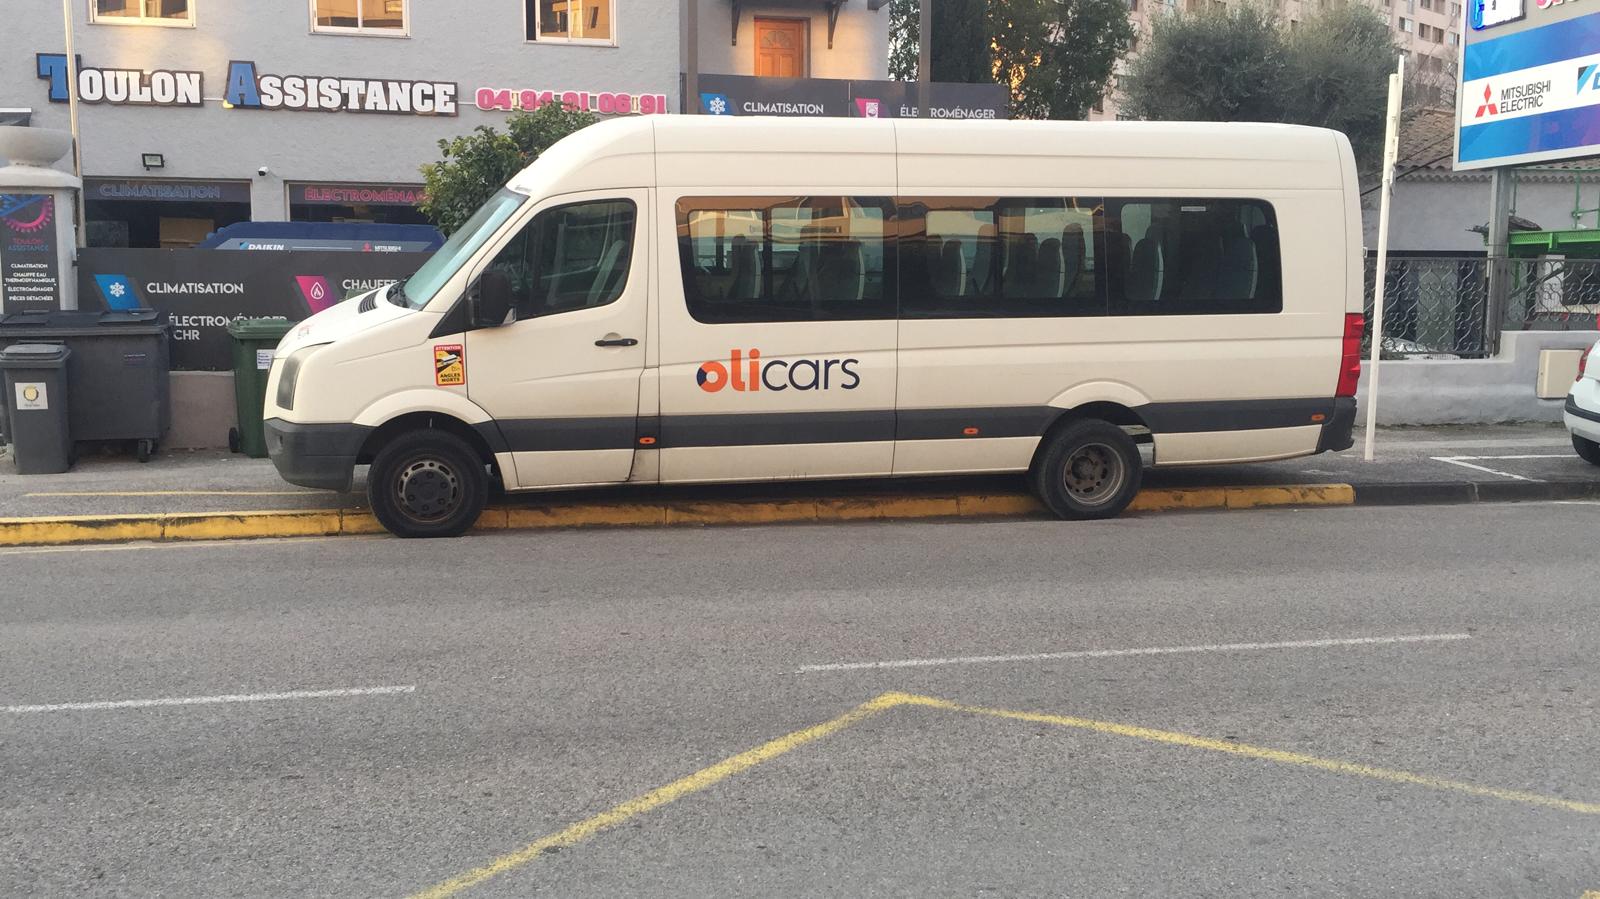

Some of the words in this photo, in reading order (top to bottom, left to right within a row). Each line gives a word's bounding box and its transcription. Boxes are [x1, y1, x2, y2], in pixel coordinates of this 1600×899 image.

[37, 54, 203, 105] TOULON
[227, 61, 457, 114] ASSISTANCE
[1501, 80, 1551, 100] MITSUBISHI
[477, 88, 512, 110] 04
[519, 90, 553, 111] 94
[598, 93, 632, 114] 06
[640, 94, 666, 115] 91
[743, 102, 824, 114] CLIMATISATION
[1500, 95, 1544, 114] ELECTRIC
[900, 104, 996, 119] ÉLEROMÉNAGER
[99, 183, 221, 199] CLIMATISATION
[146, 282, 244, 294] CLIMATISATION
[173, 329, 200, 340] CHR
[697, 348, 860, 393] olicars
